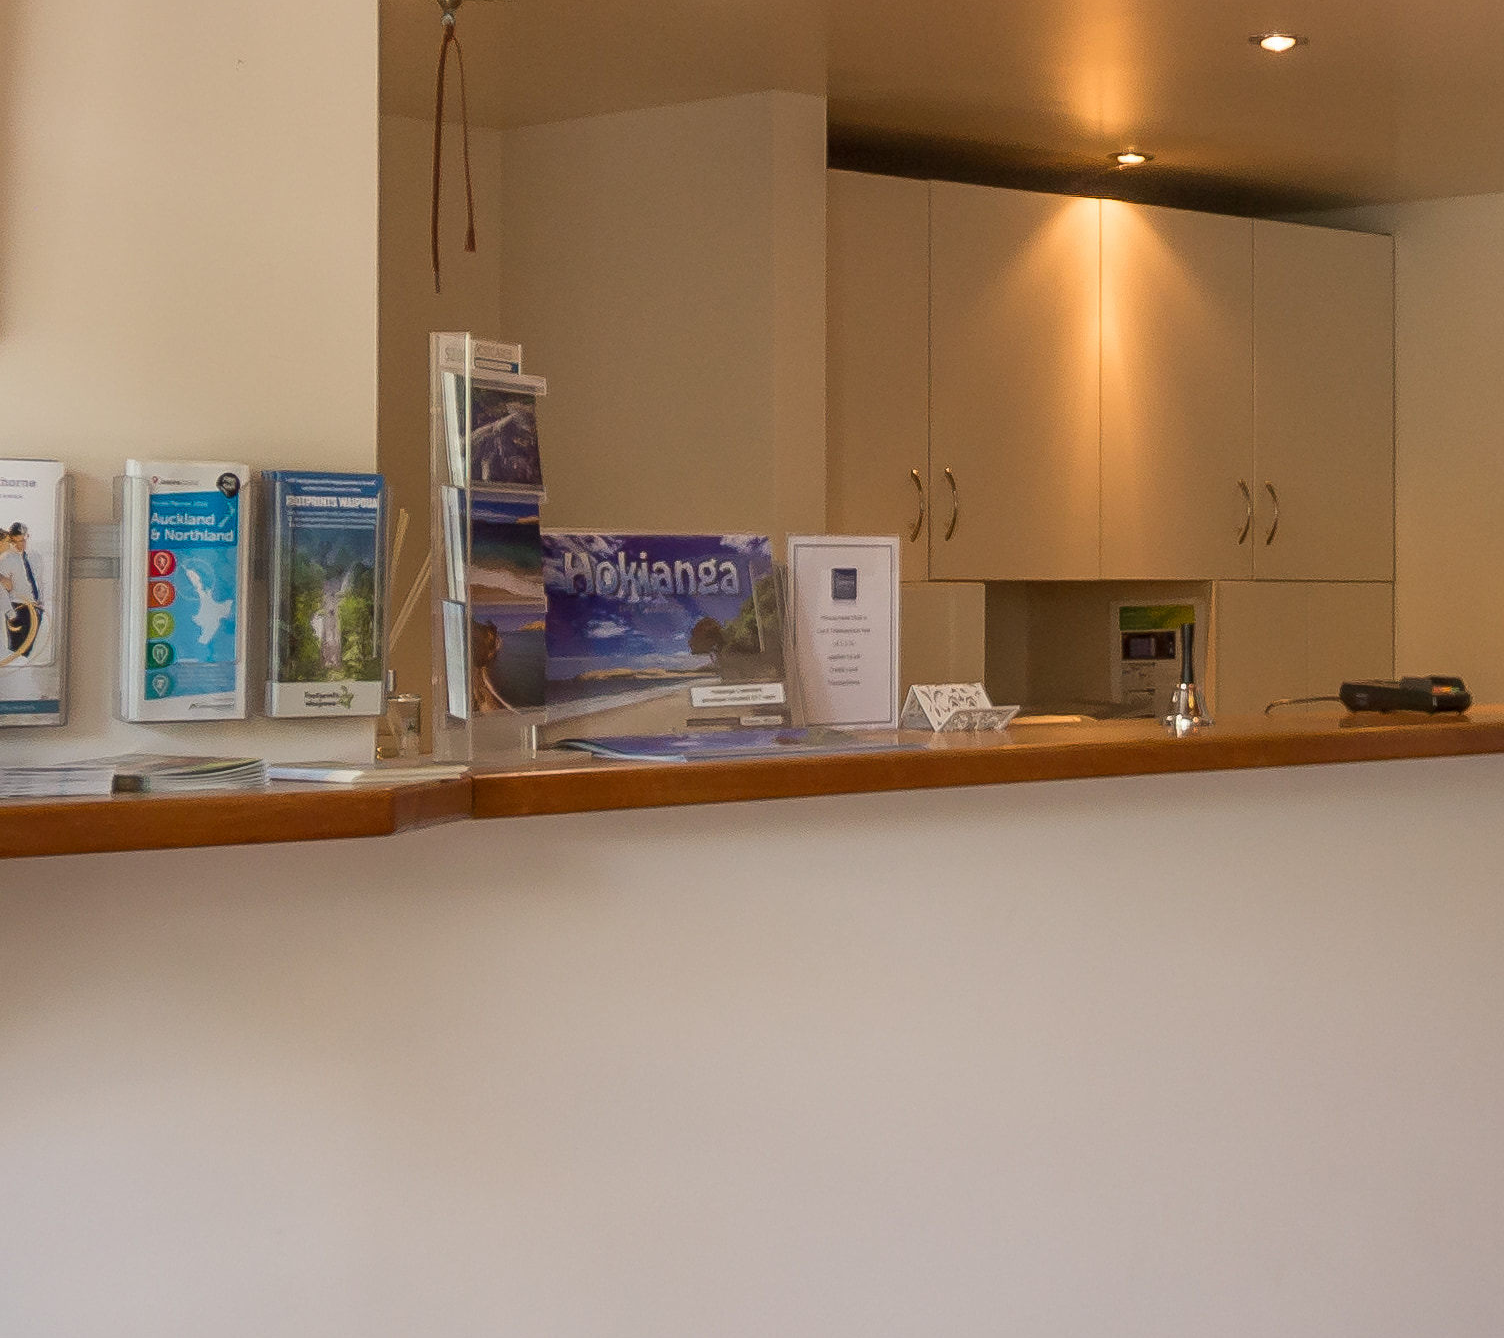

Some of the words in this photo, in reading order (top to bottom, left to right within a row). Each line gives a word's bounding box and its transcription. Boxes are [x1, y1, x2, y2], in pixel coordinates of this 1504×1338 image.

[151, 512, 215, 526] Auckland
[164, 528, 234, 542] Northland
[563, 551, 740, 603] Hokianga
